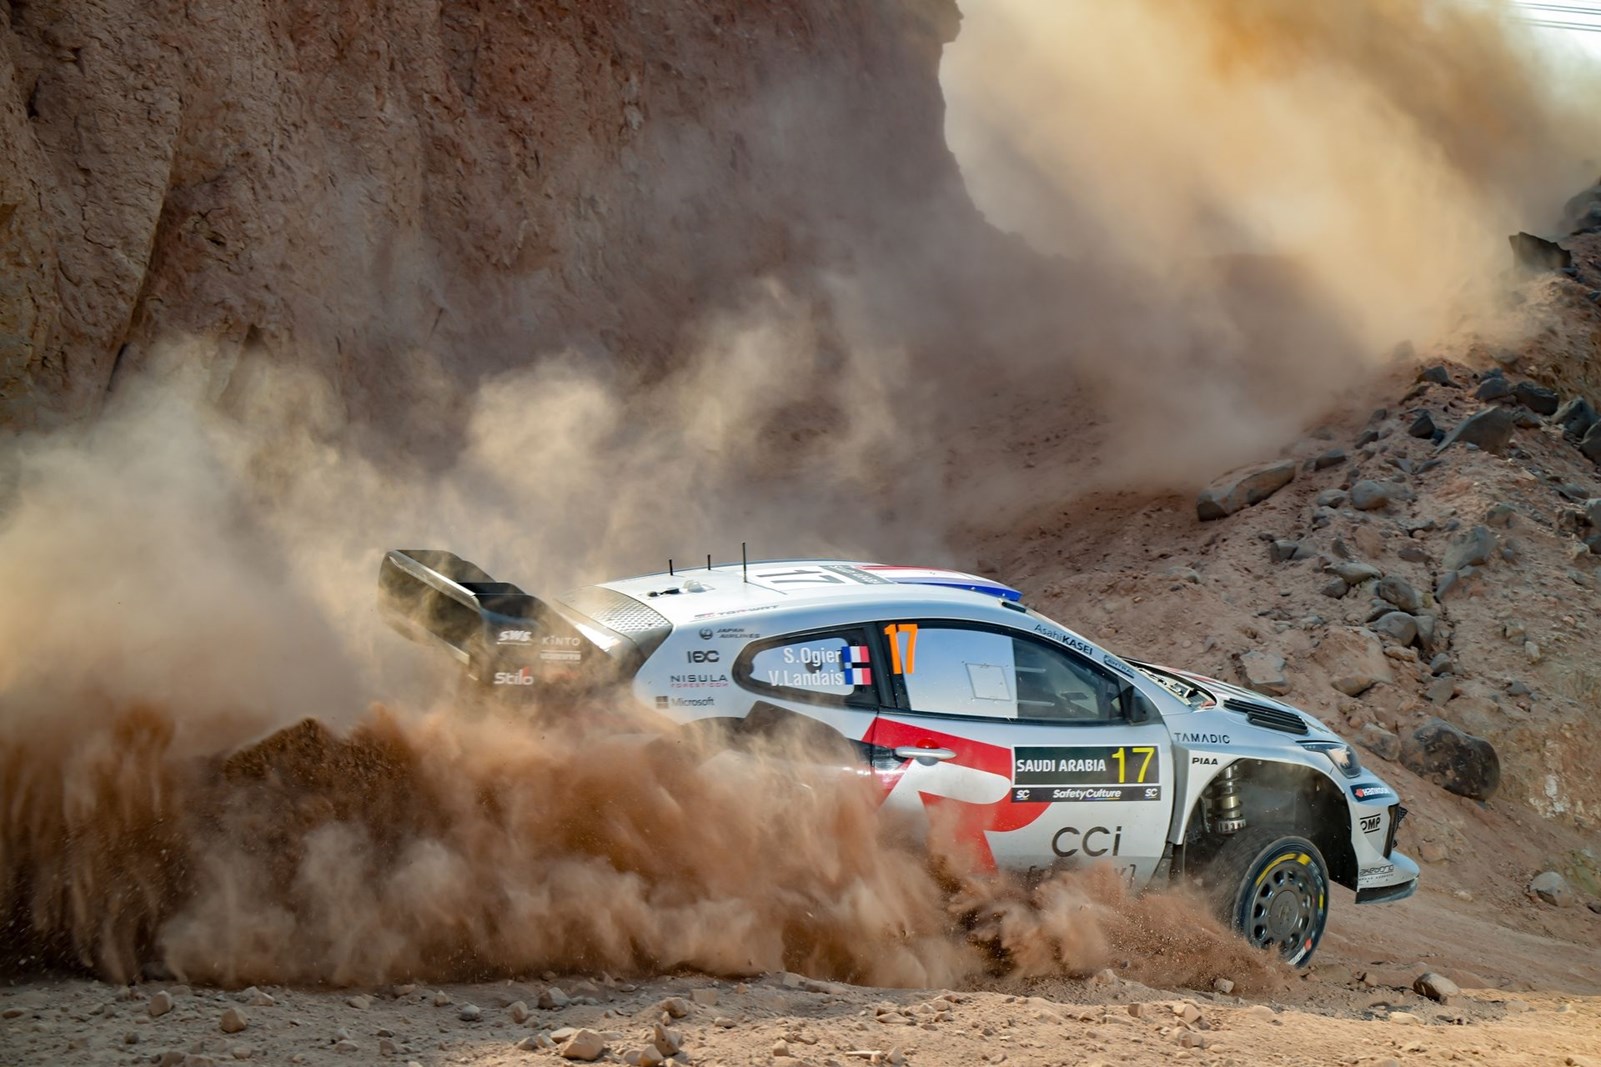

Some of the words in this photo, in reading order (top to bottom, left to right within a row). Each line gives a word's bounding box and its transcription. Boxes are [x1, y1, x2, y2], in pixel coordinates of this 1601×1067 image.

[1034, 623, 1094, 656] AsahiKASEI
[884, 623, 918, 675] 17
[783, 647, 842, 667] S.Ogier
[493, 668, 535, 686] Stilo
[670, 674, 729, 683] NISULA
[768, 669, 845, 687] V.Landais
[671, 696, 716, 707] Microsoft
[1173, 732, 1231, 744] TAMADIC
[1016, 759, 1056, 772] SAUDI
[1058, 759, 1107, 772] ARABIA
[1111, 746, 1155, 784] 17
[1191, 757, 1219, 766] PIAA
[1016, 789, 1031, 799] SC
[1144, 788, 1158, 798] SC
[1360, 816, 1381, 831] OMP
